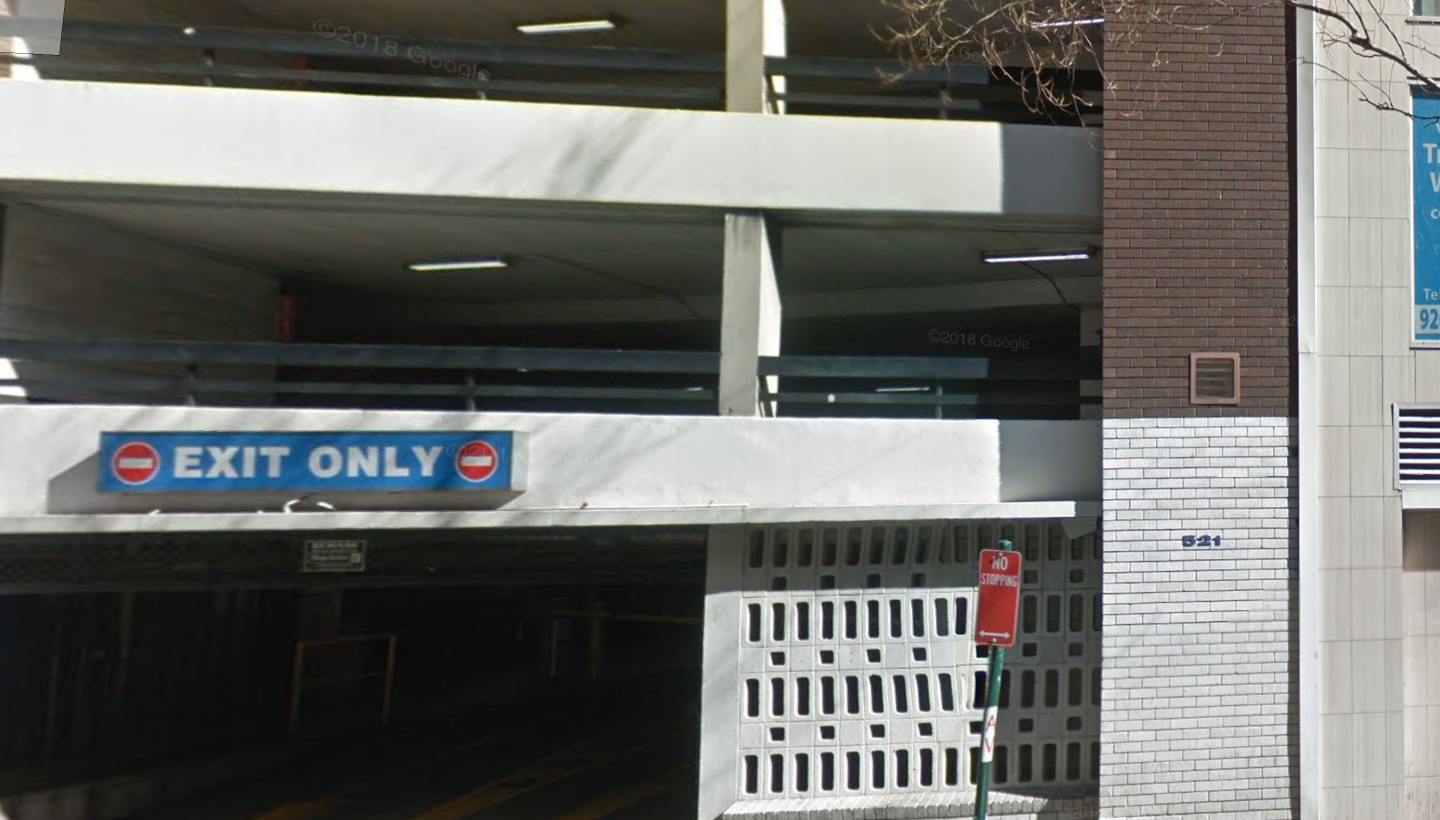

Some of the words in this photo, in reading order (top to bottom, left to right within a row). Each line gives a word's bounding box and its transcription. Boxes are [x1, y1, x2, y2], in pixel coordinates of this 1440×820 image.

[172, 446, 290, 478] EXIT
[308, 446, 444, 478] ONLY
[1182, 535, 1221, 547] 521
[992, 555, 1008, 570] NO
[981, 573, 1018, 587] STOPPING
